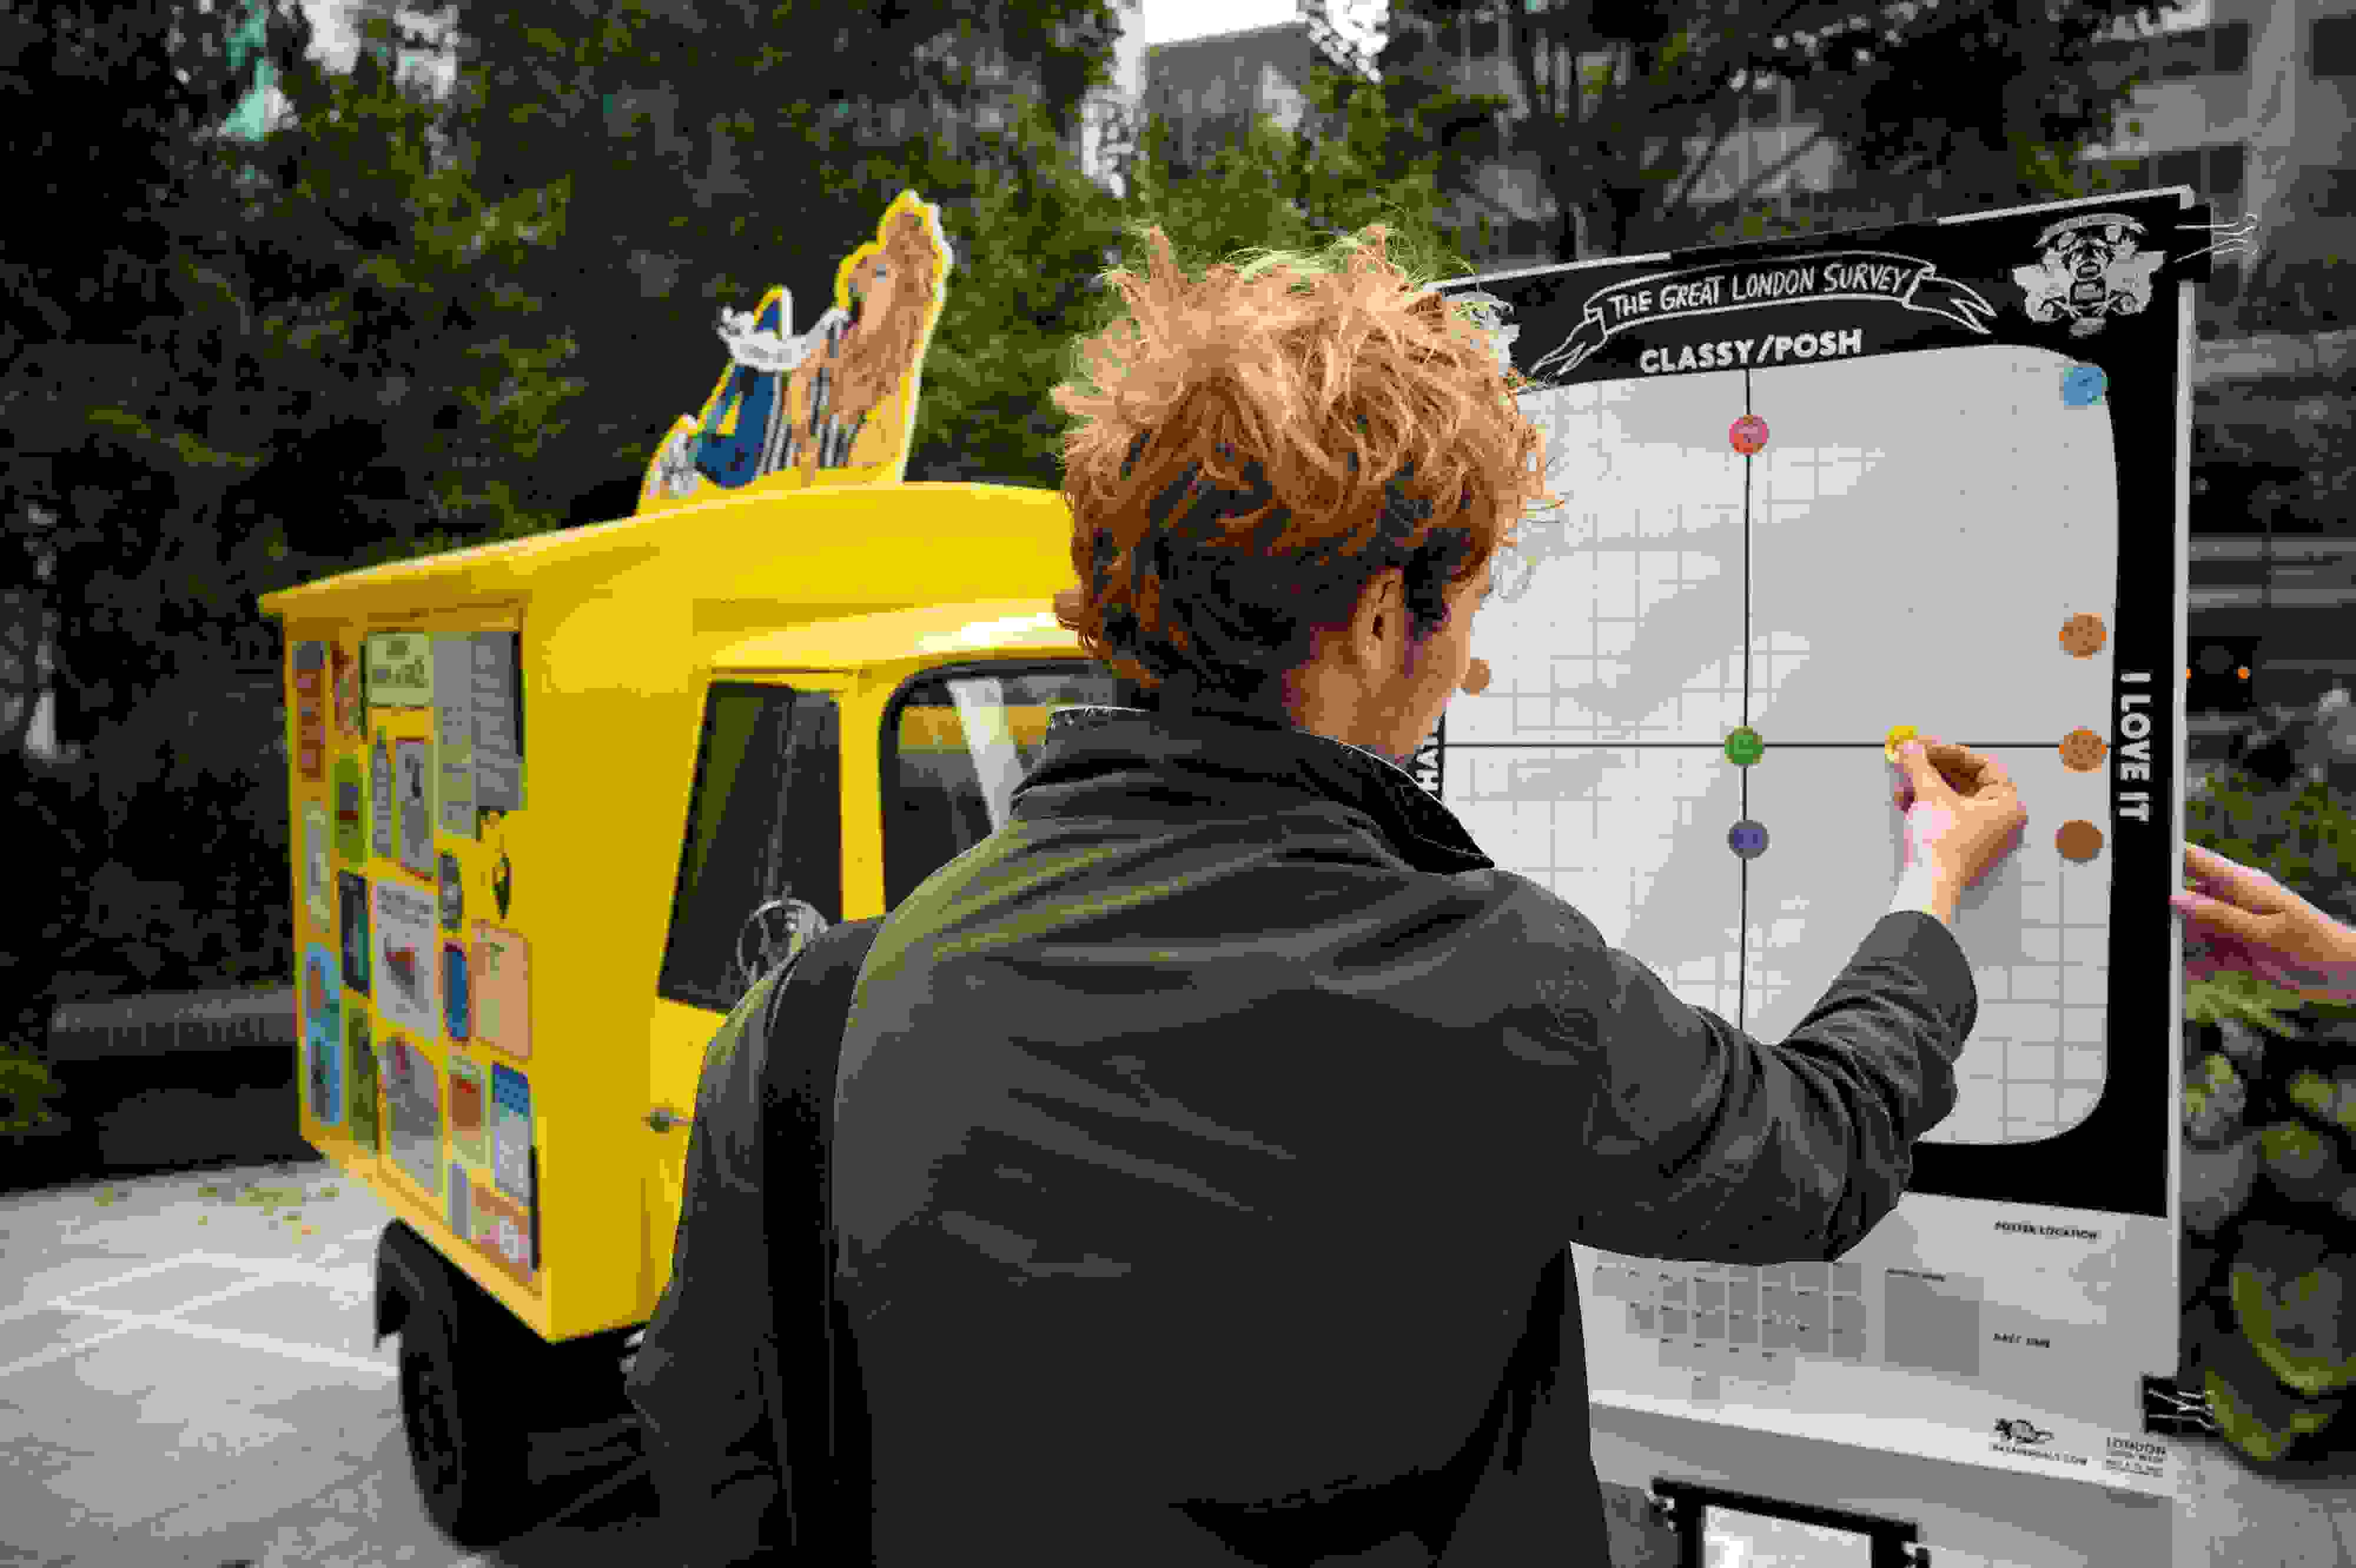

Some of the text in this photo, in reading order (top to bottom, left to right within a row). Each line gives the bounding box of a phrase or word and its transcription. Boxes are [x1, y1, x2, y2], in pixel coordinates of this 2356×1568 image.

[1607, 263, 1910, 320] THE GREAT LONDON SURVEY
[1639, 329, 1863, 373] CLASSY/POSH
[2119, 673, 2151, 822] I LOVE IT
[2040, 1226, 2097, 1240] LOCATION
